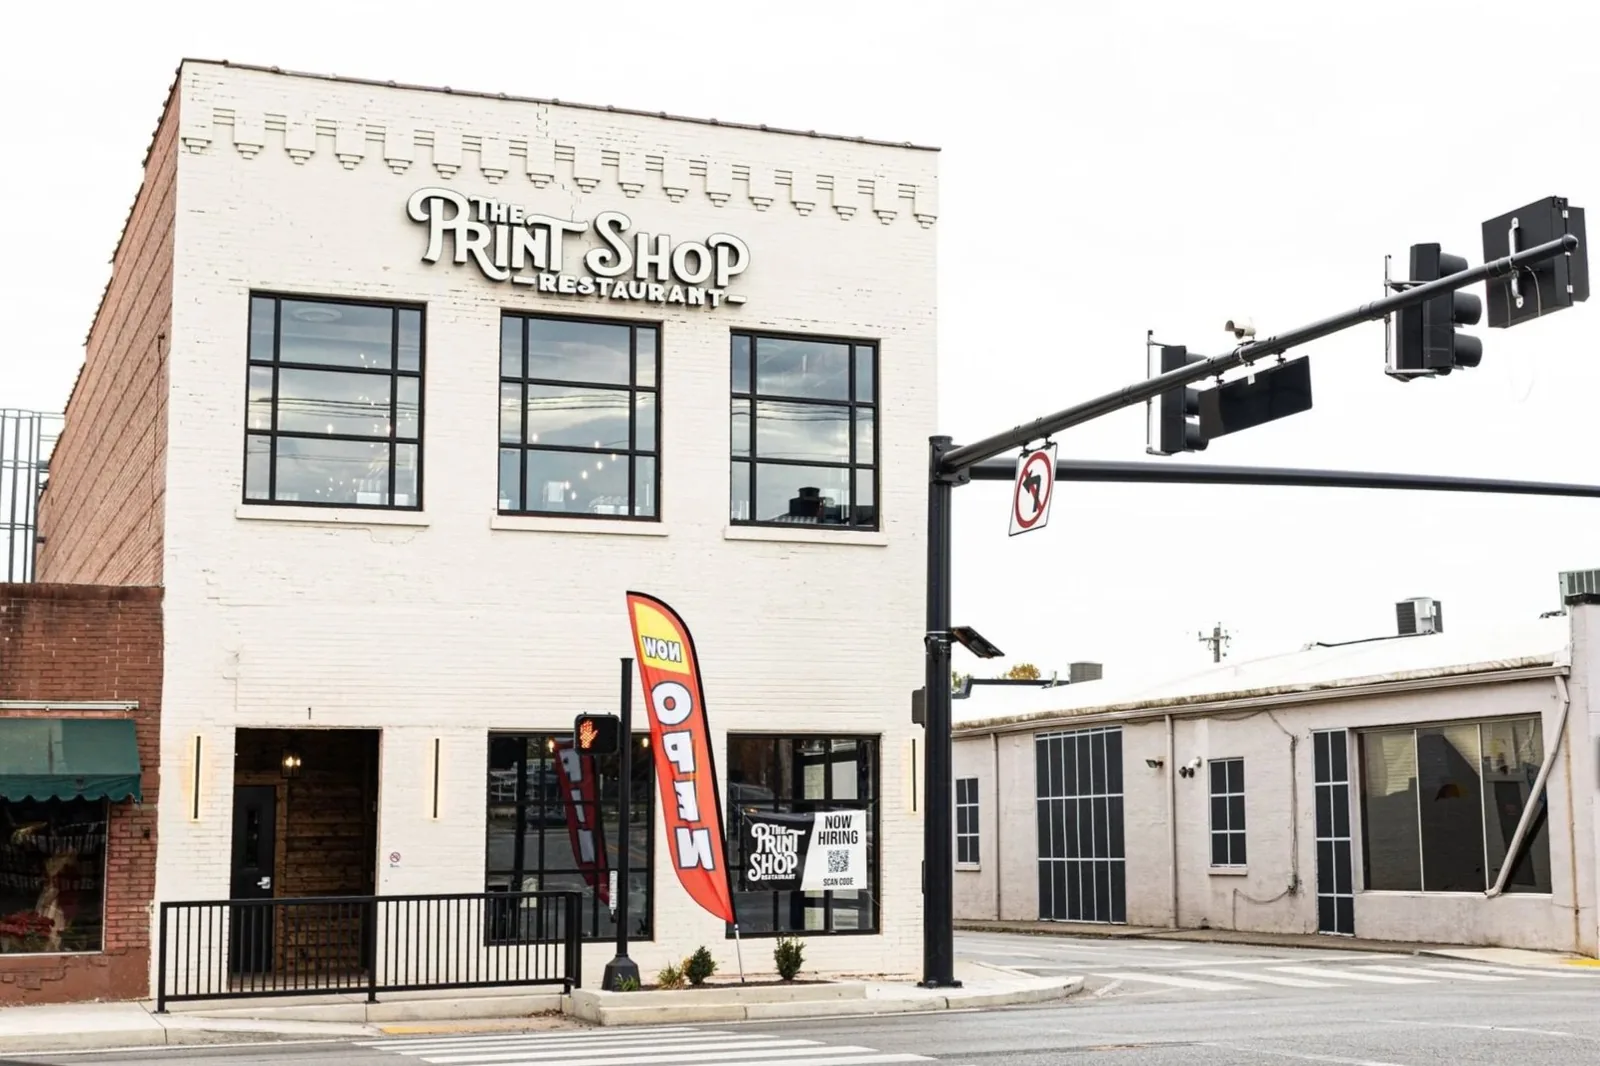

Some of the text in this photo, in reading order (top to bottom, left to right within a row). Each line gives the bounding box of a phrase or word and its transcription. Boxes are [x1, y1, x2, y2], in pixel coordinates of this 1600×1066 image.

[468, 195, 525, 224] THE
[407, 187, 750, 288] PRINT SHOP
[537, 273, 726, 307] RESTAURANT
[769, 824, 787, 835] THE
[825, 815, 853, 829] NOW
[751, 823, 806, 858] PRINT
[818, 830, 859, 845] HIRING
[748, 851, 798, 881] SHOP
[823, 877, 854, 886] SCAN CODE
